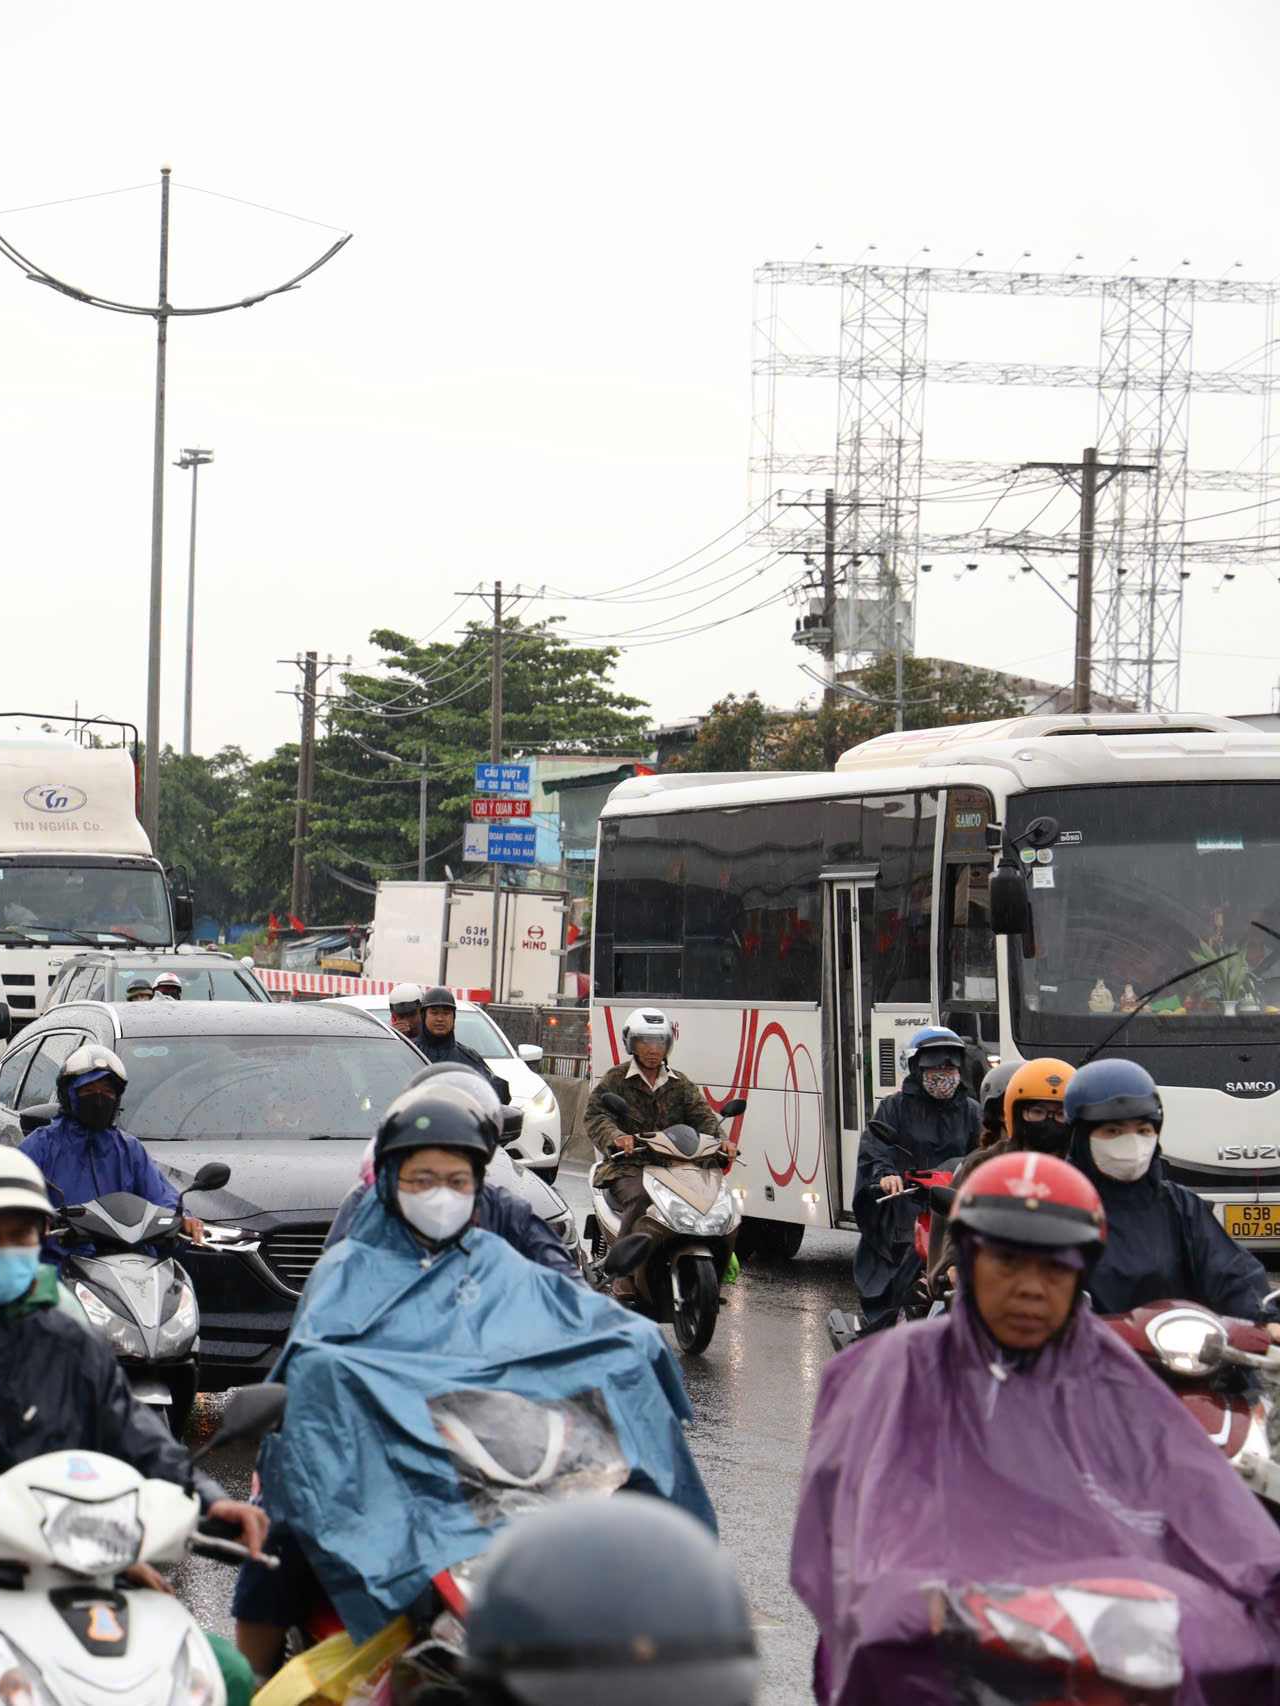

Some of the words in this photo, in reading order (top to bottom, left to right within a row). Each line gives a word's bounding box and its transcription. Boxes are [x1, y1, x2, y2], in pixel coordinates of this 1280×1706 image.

[955, 813, 982, 828] SAMCO
[465, 925, 487, 936] 63H
[460, 936, 490, 947] 03149
[522, 940, 547, 950] HINO
[1226, 1081, 1276, 1092] SAMCO
[1217, 1144, 1280, 1160] ISUZ
[1243, 1207, 1270, 1221] 63B
